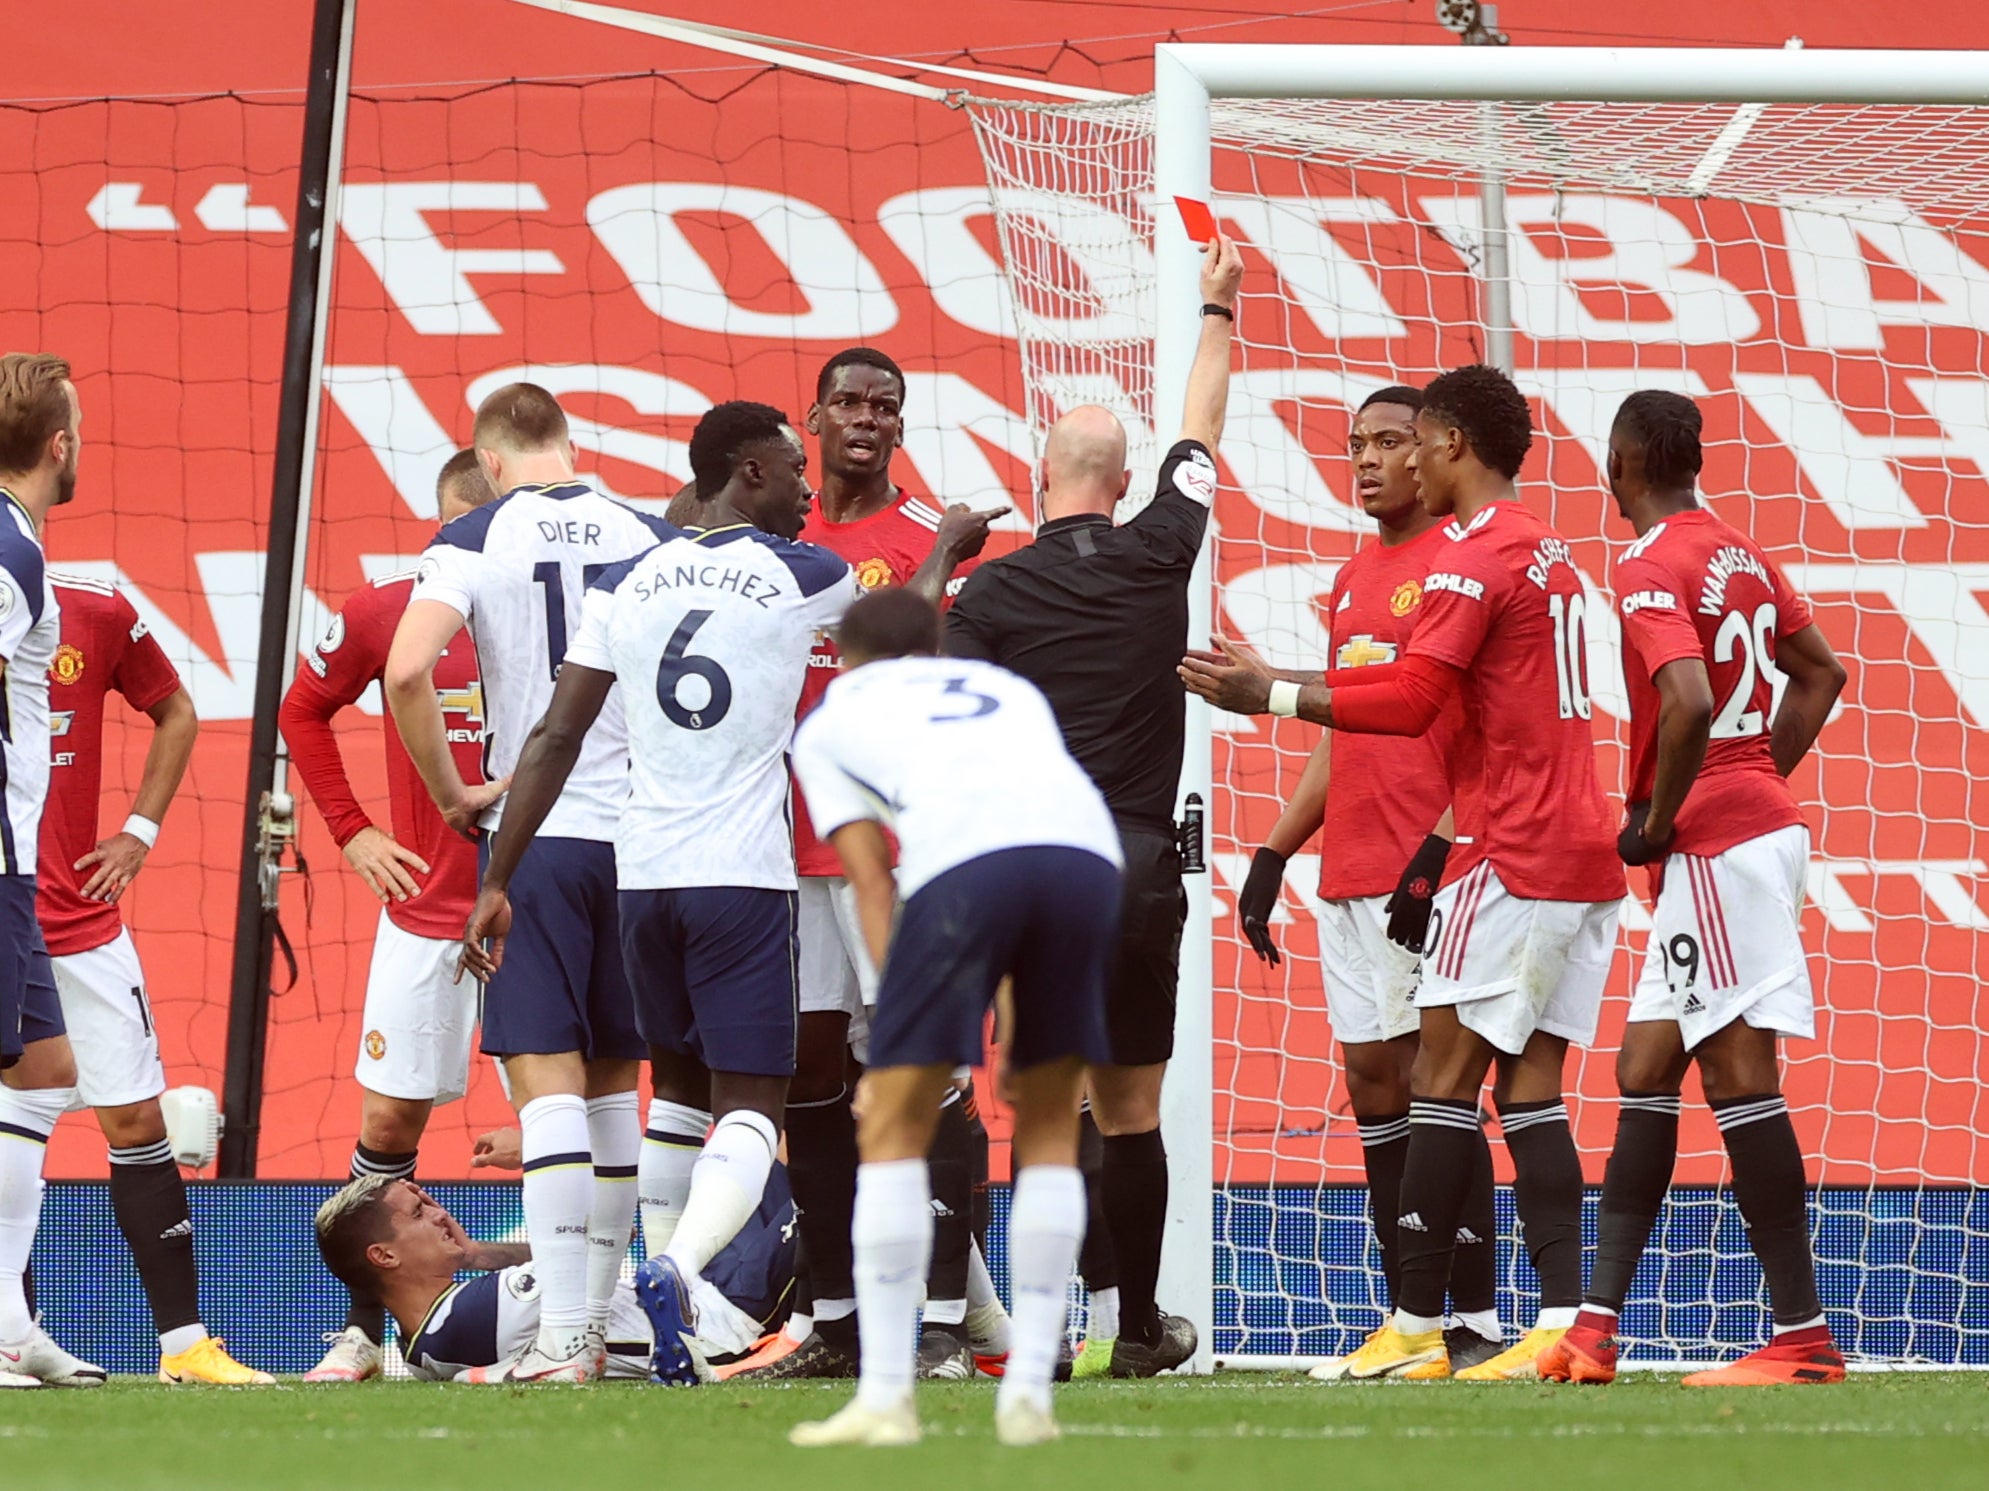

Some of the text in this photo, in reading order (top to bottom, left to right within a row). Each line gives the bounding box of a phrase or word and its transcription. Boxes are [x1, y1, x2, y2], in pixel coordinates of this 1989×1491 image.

[537, 520, 601, 545] DIER
[634, 564, 781, 608] SÁNCHEZ
[1621, 590, 1677, 616] OHLER
[656, 609, 732, 730] 6
[1548, 593, 1592, 720] 10
[1709, 602, 1777, 739] 29
[928, 677, 1001, 722] 3
[1660, 933, 1699, 993] 9
[555, 1226, 589, 1235] SPURS
